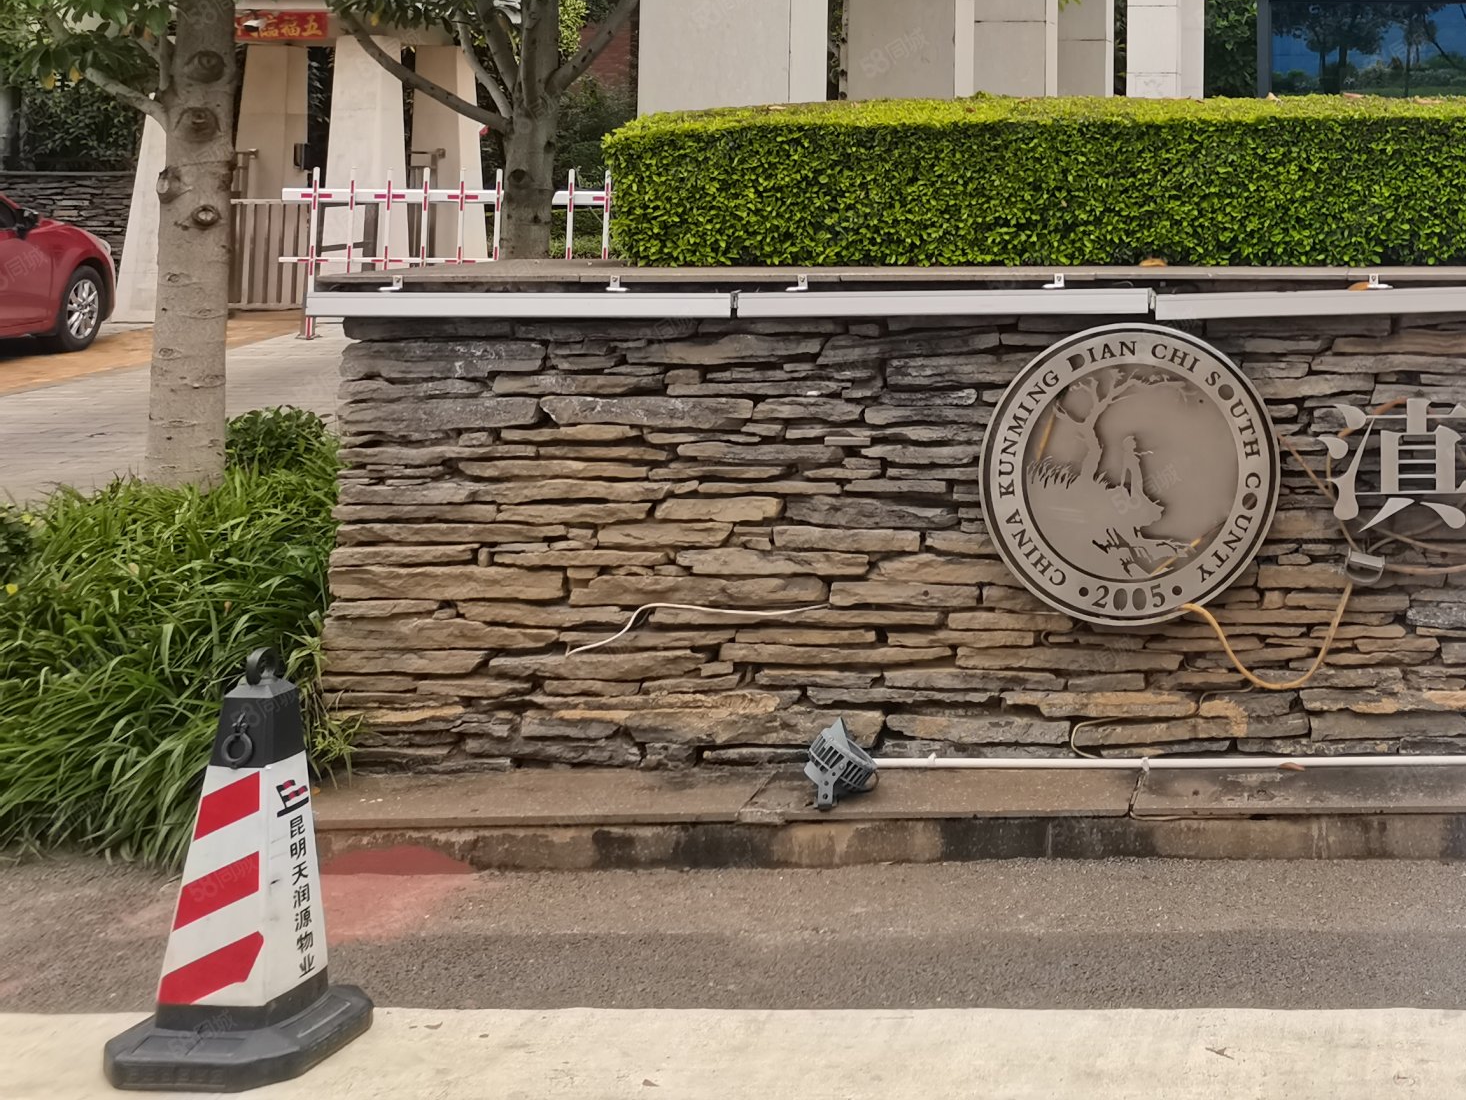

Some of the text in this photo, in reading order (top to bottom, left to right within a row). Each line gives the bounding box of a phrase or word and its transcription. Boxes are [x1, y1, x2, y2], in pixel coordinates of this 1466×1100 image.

[999, 340, 1262, 587] CHINA KUNMING DIAN CHI SOUTH COUNTY
[289, 814, 315, 979] 昆明天润源物业
